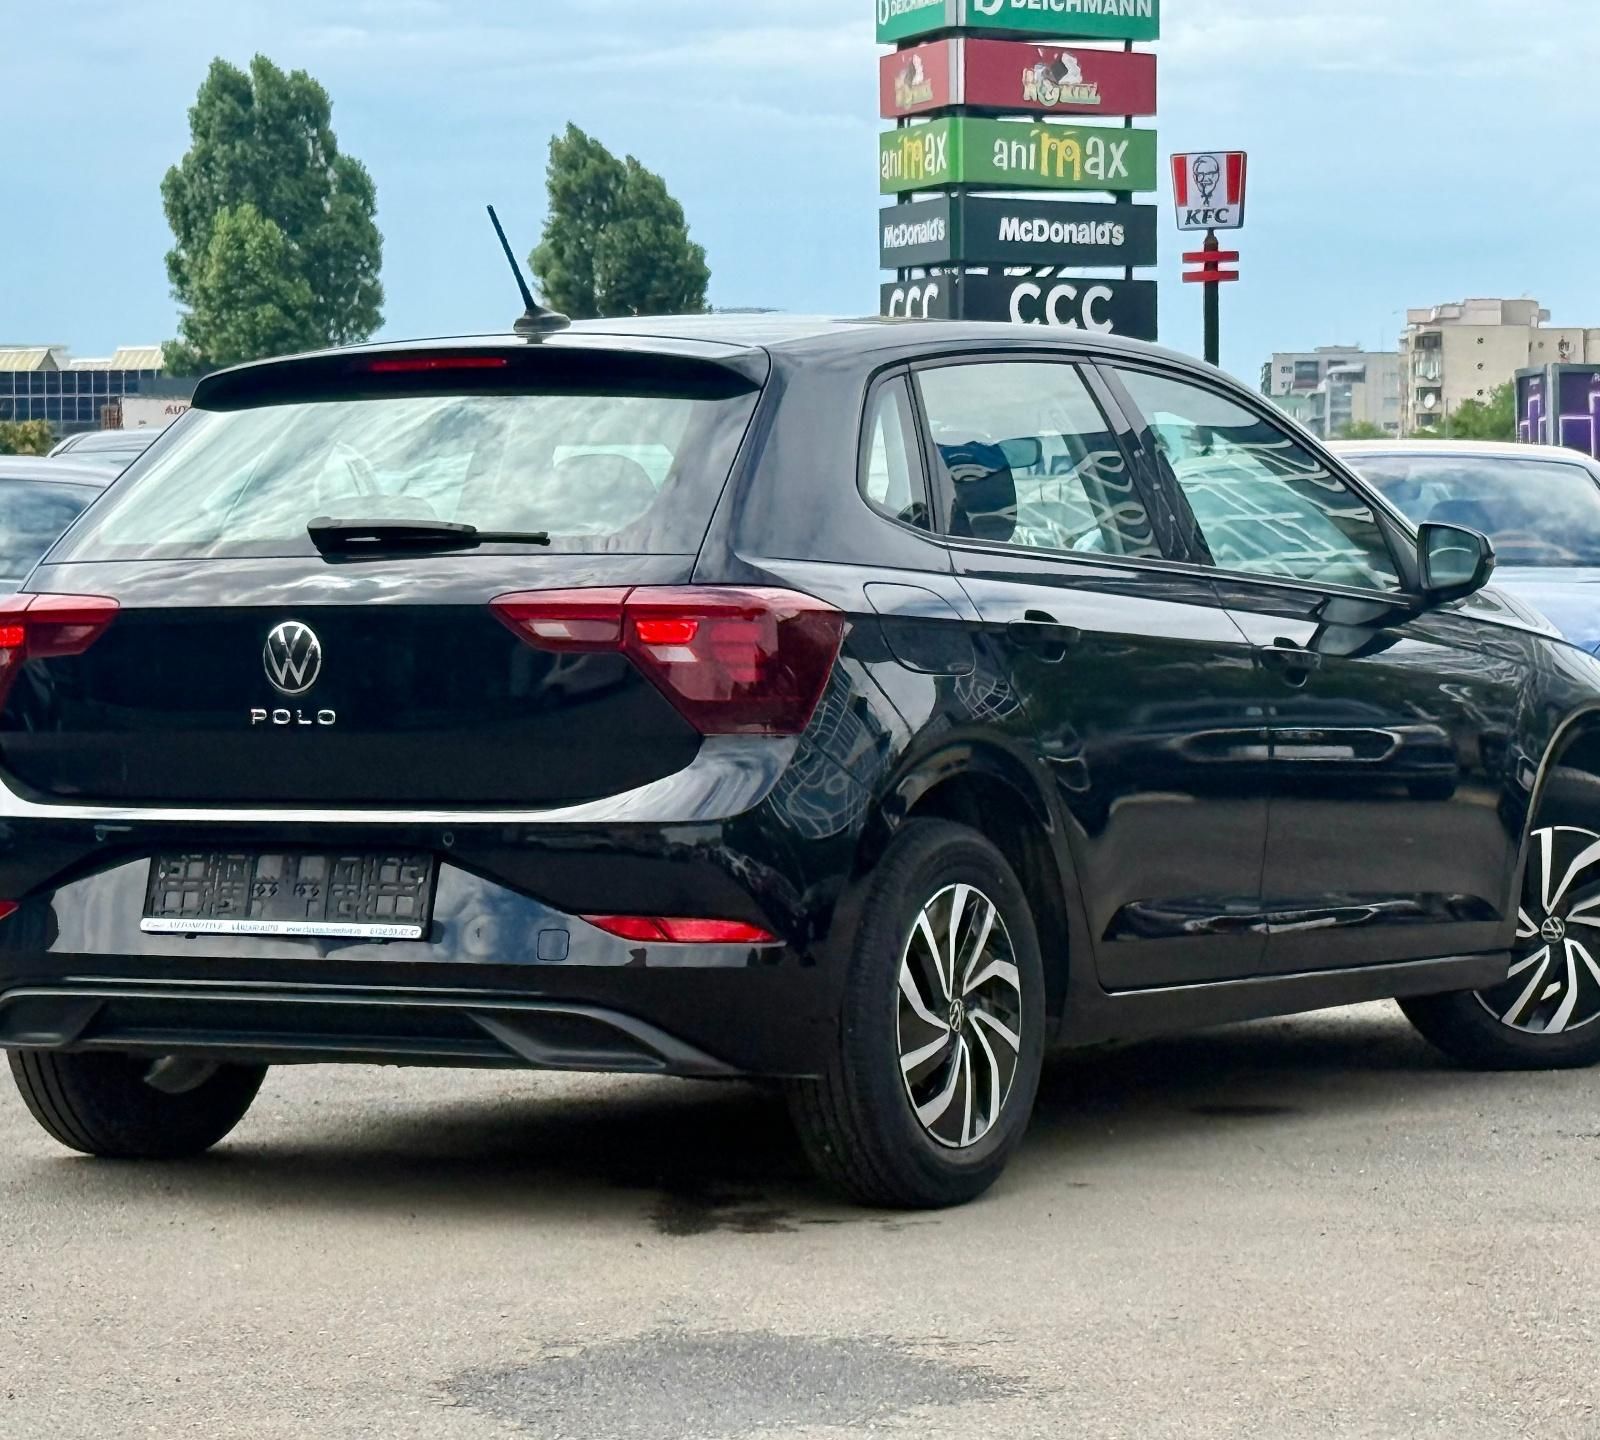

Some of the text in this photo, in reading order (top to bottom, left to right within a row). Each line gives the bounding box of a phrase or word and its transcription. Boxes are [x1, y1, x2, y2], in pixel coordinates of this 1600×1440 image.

[881, 130, 947, 180] animax
[992, 130, 1129, 181] animax
[998, 216, 1125, 246] McDonald's
[1185, 208, 1230, 225] KFC
[883, 217, 946, 249] McDonald's
[1009, 282, 1114, 334] CCC
[250, 708, 336, 725] POLO
